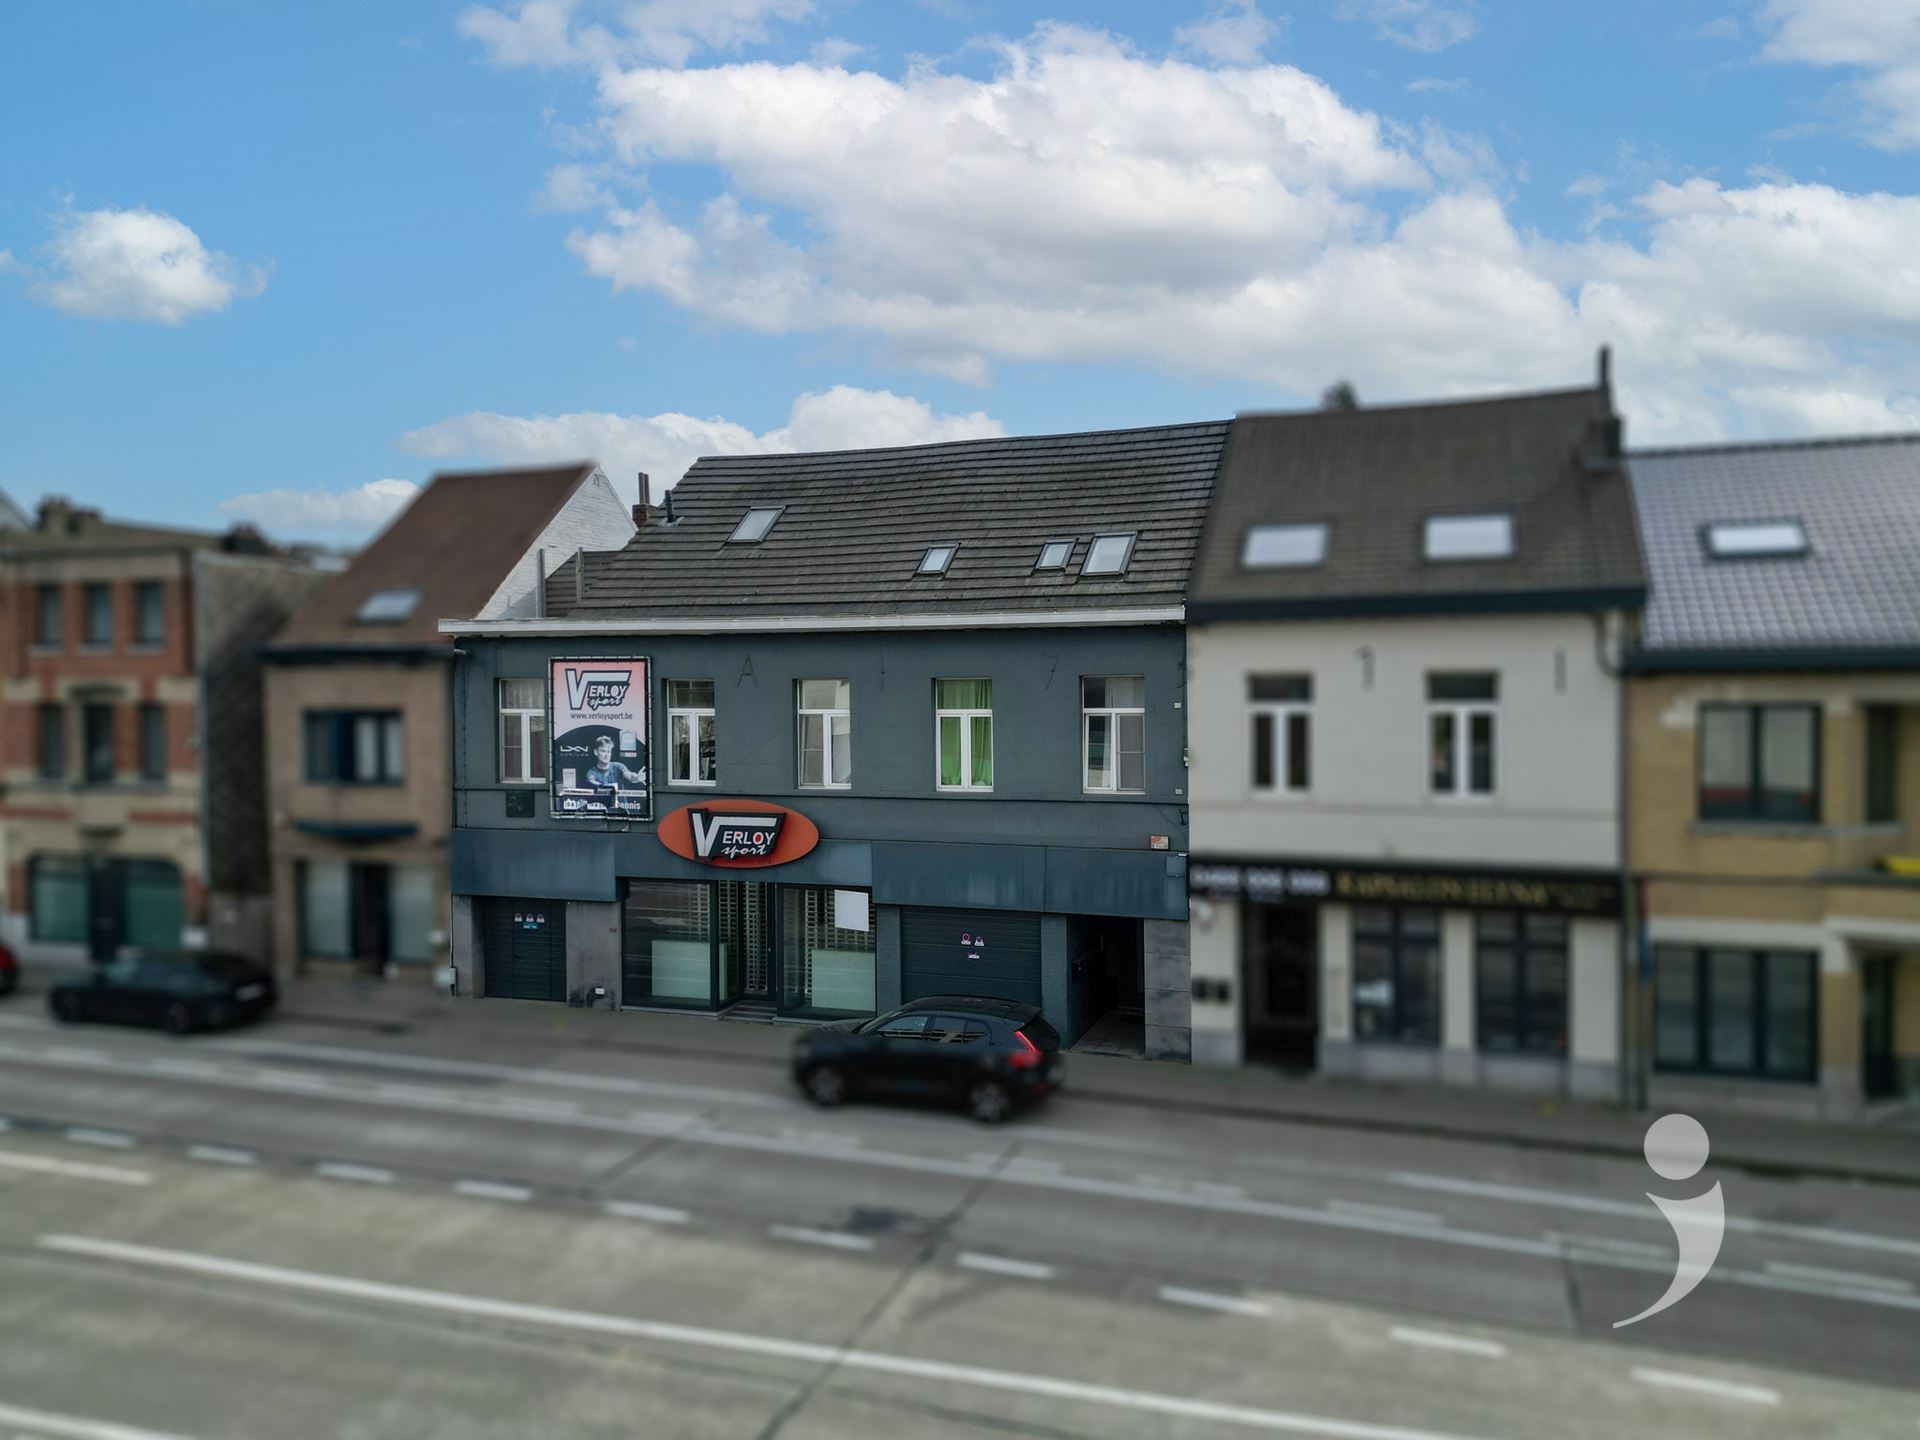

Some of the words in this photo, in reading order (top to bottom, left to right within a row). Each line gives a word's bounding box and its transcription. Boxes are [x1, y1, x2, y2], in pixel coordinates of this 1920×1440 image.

[566, 668, 631, 709] VERLOY
[589, 696, 622, 709] sport
[570, 712, 633, 721] www.verloysport.be
[691, 812, 778, 857] VERLOY
[720, 843, 768, 860] sport
